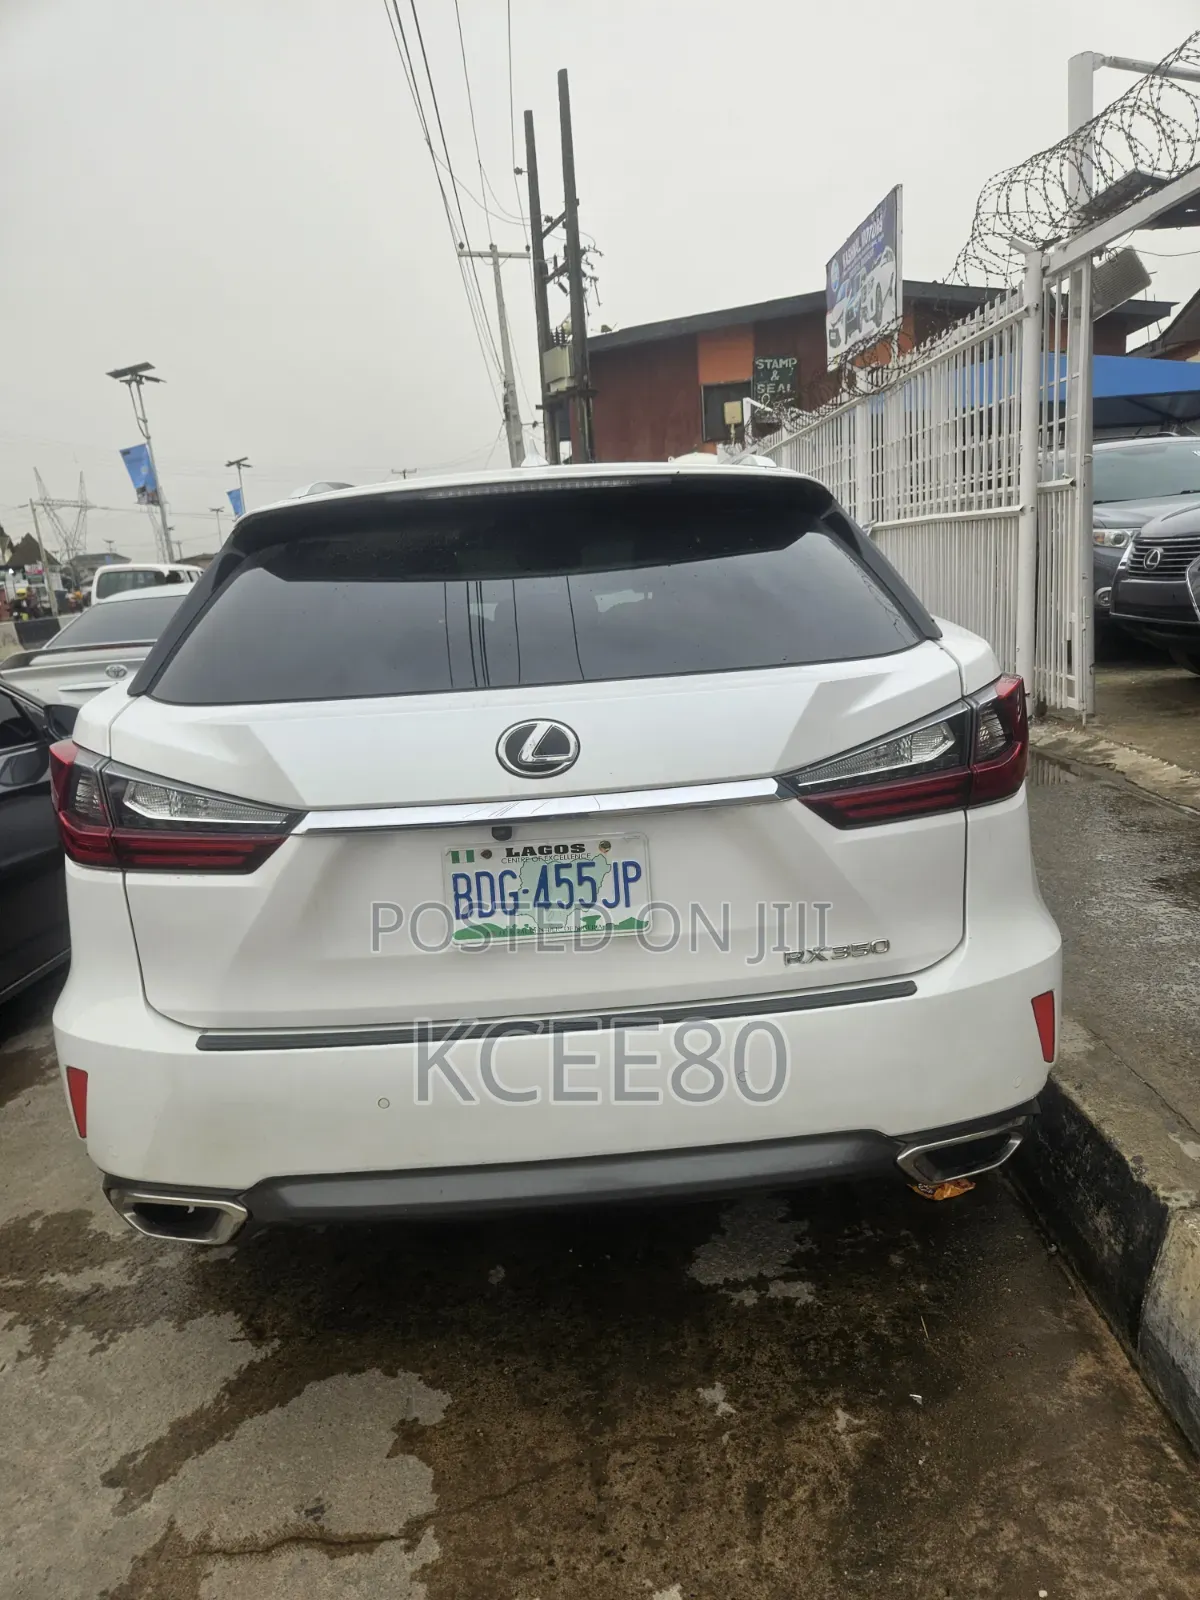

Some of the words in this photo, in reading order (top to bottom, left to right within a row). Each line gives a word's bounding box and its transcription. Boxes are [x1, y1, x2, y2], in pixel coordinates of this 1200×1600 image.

[755, 358, 797, 369] STAMP
[770, 369, 780, 381] &
[757, 383, 795, 393] SEAL
[505, 843, 586, 858] LAGOS
[501, 855, 530, 865] CENTRE
[544, 852, 592, 862] EXCELLENCE
